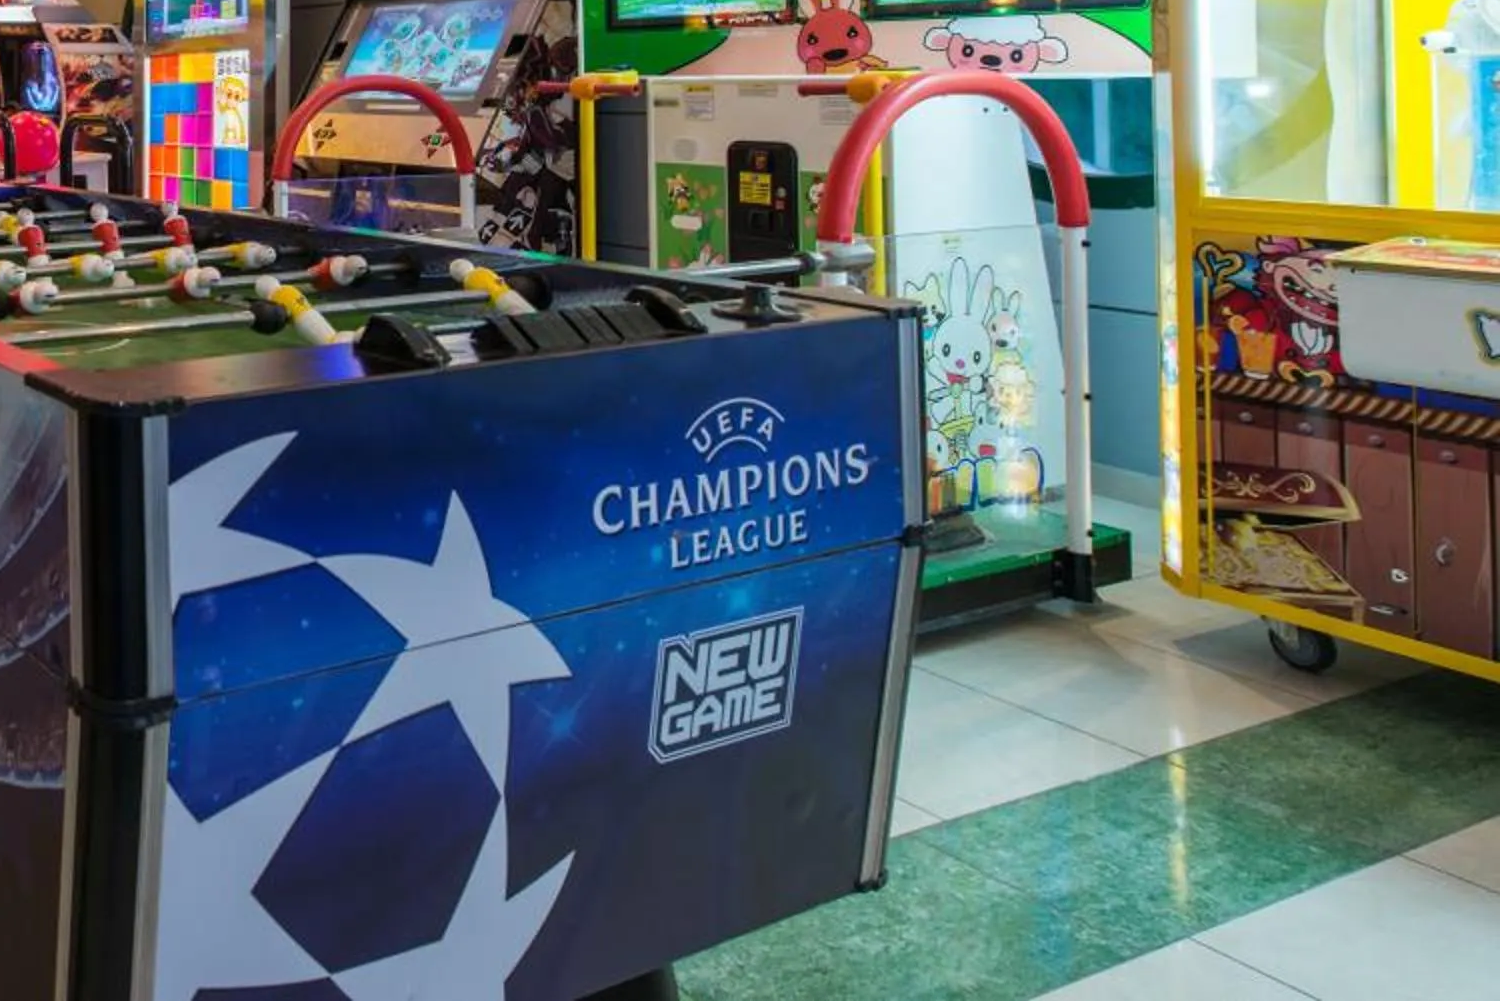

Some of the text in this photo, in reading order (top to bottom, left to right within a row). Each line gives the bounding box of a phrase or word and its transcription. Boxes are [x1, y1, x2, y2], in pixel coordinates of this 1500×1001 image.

[692, 406, 774, 453] UEFA
[592, 443, 871, 537] CHAMPIONS
[669, 510, 809, 569] LEAGUE
[663, 622, 791, 705] NEW
[660, 677, 782, 746] GAME
